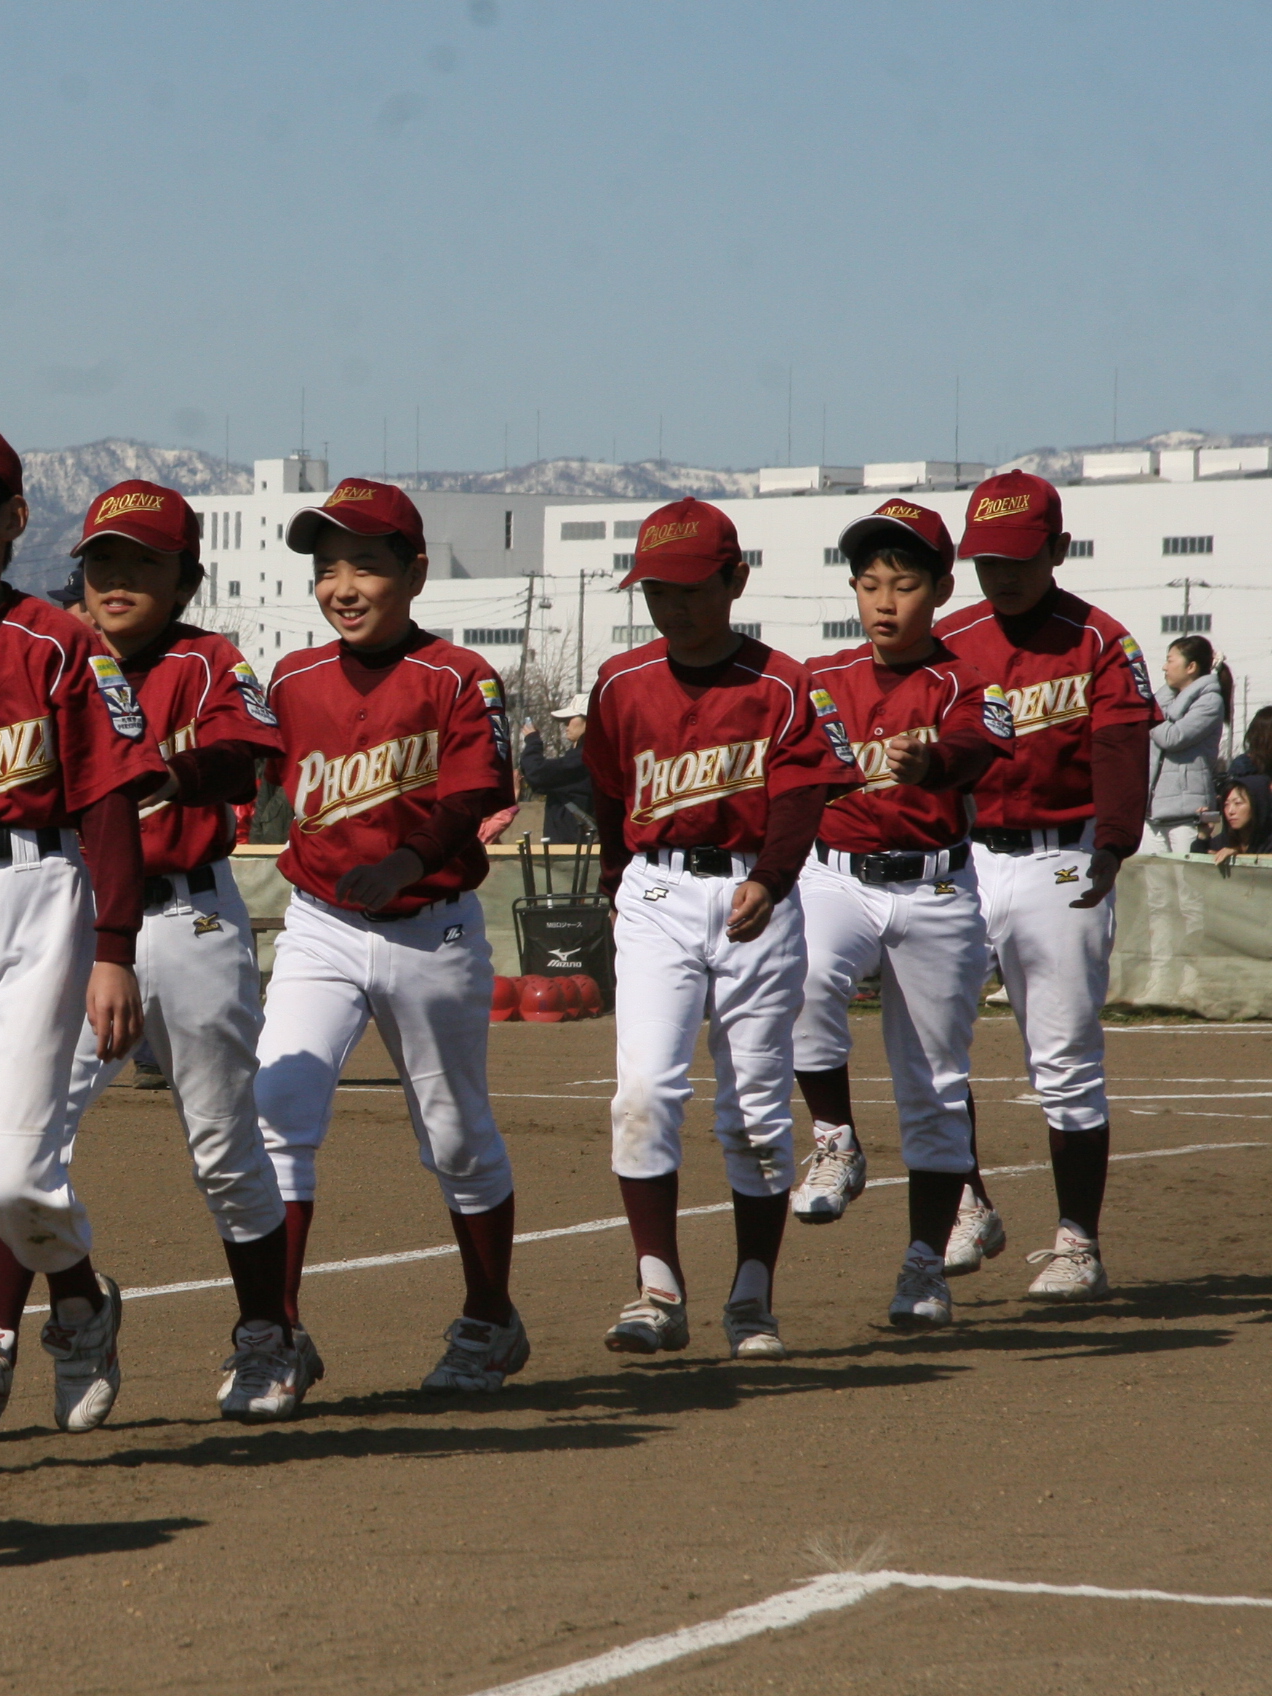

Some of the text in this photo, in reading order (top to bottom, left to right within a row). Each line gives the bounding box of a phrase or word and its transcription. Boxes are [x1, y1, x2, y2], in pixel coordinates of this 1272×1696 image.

[94, 493, 164, 523] PHOENIX
[973, 494, 1030, 519] PHOENIX
[641, 521, 700, 549] PHOENIX
[630, 736, 772, 820] PHOENIX
